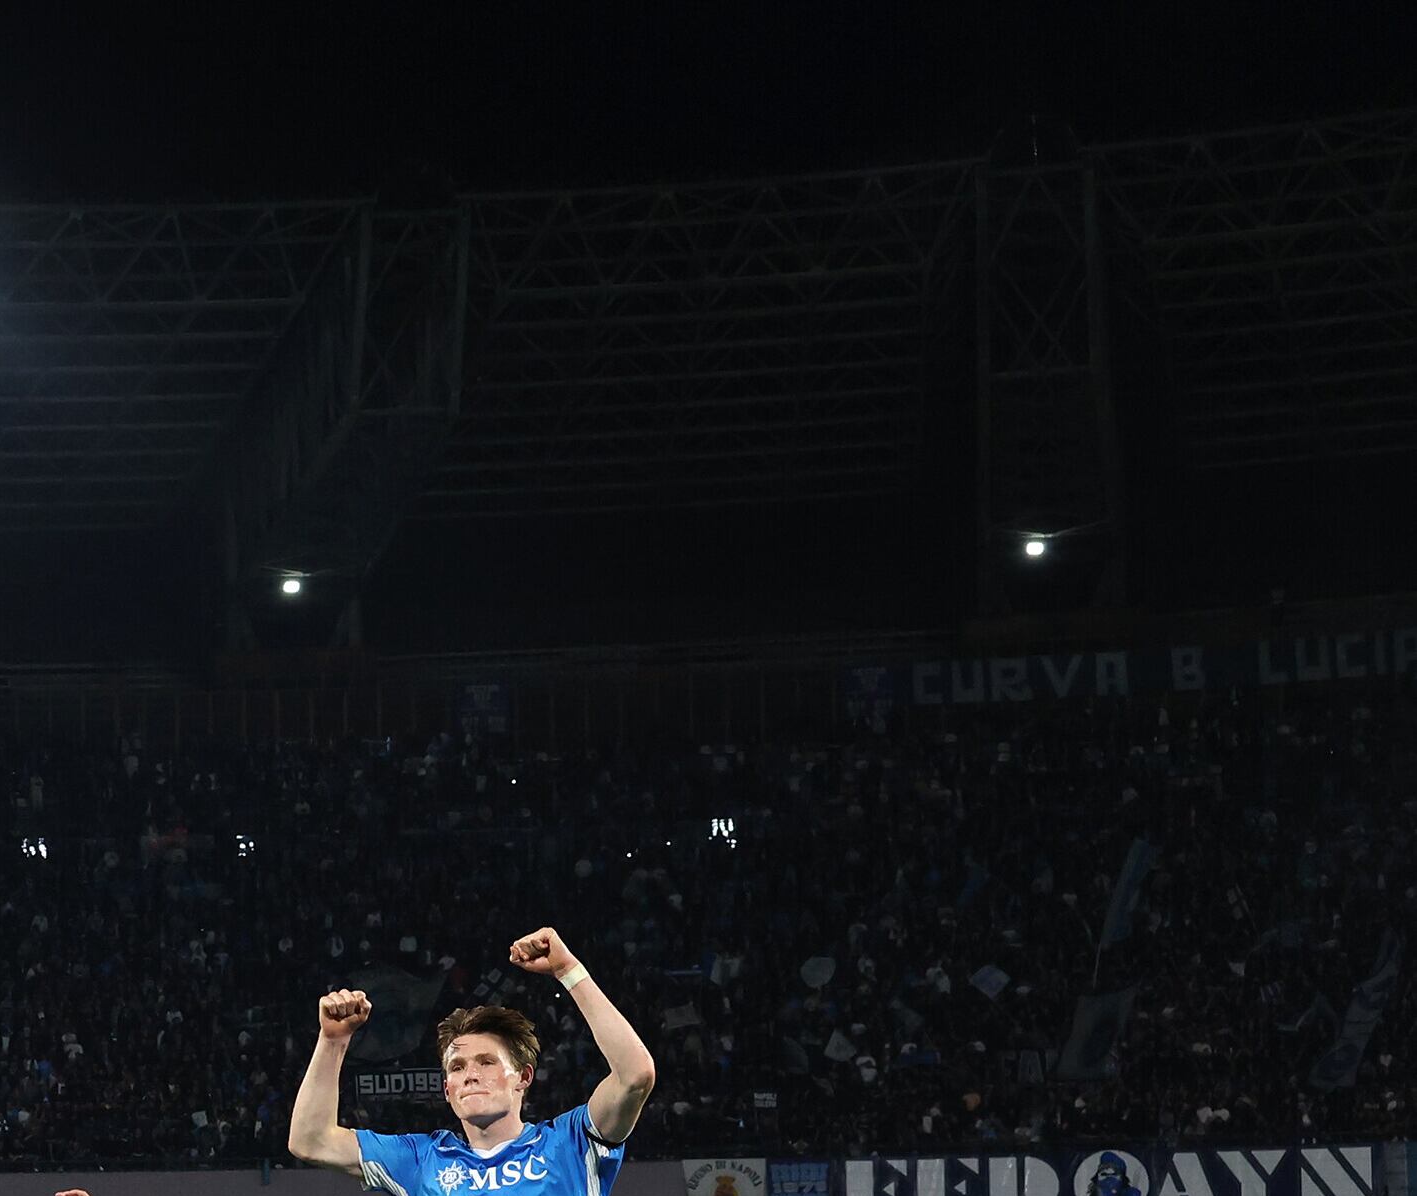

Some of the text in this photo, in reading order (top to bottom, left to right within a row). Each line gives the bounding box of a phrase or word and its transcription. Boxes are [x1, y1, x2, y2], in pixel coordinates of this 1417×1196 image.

[911, 651, 1131, 703] CURVA
[1170, 645, 1207, 691] B
[358, 1072, 443, 1095] SUD199
[468, 1154, 549, 1191] MSC
[731, 1160, 763, 1187] NAPOLI
